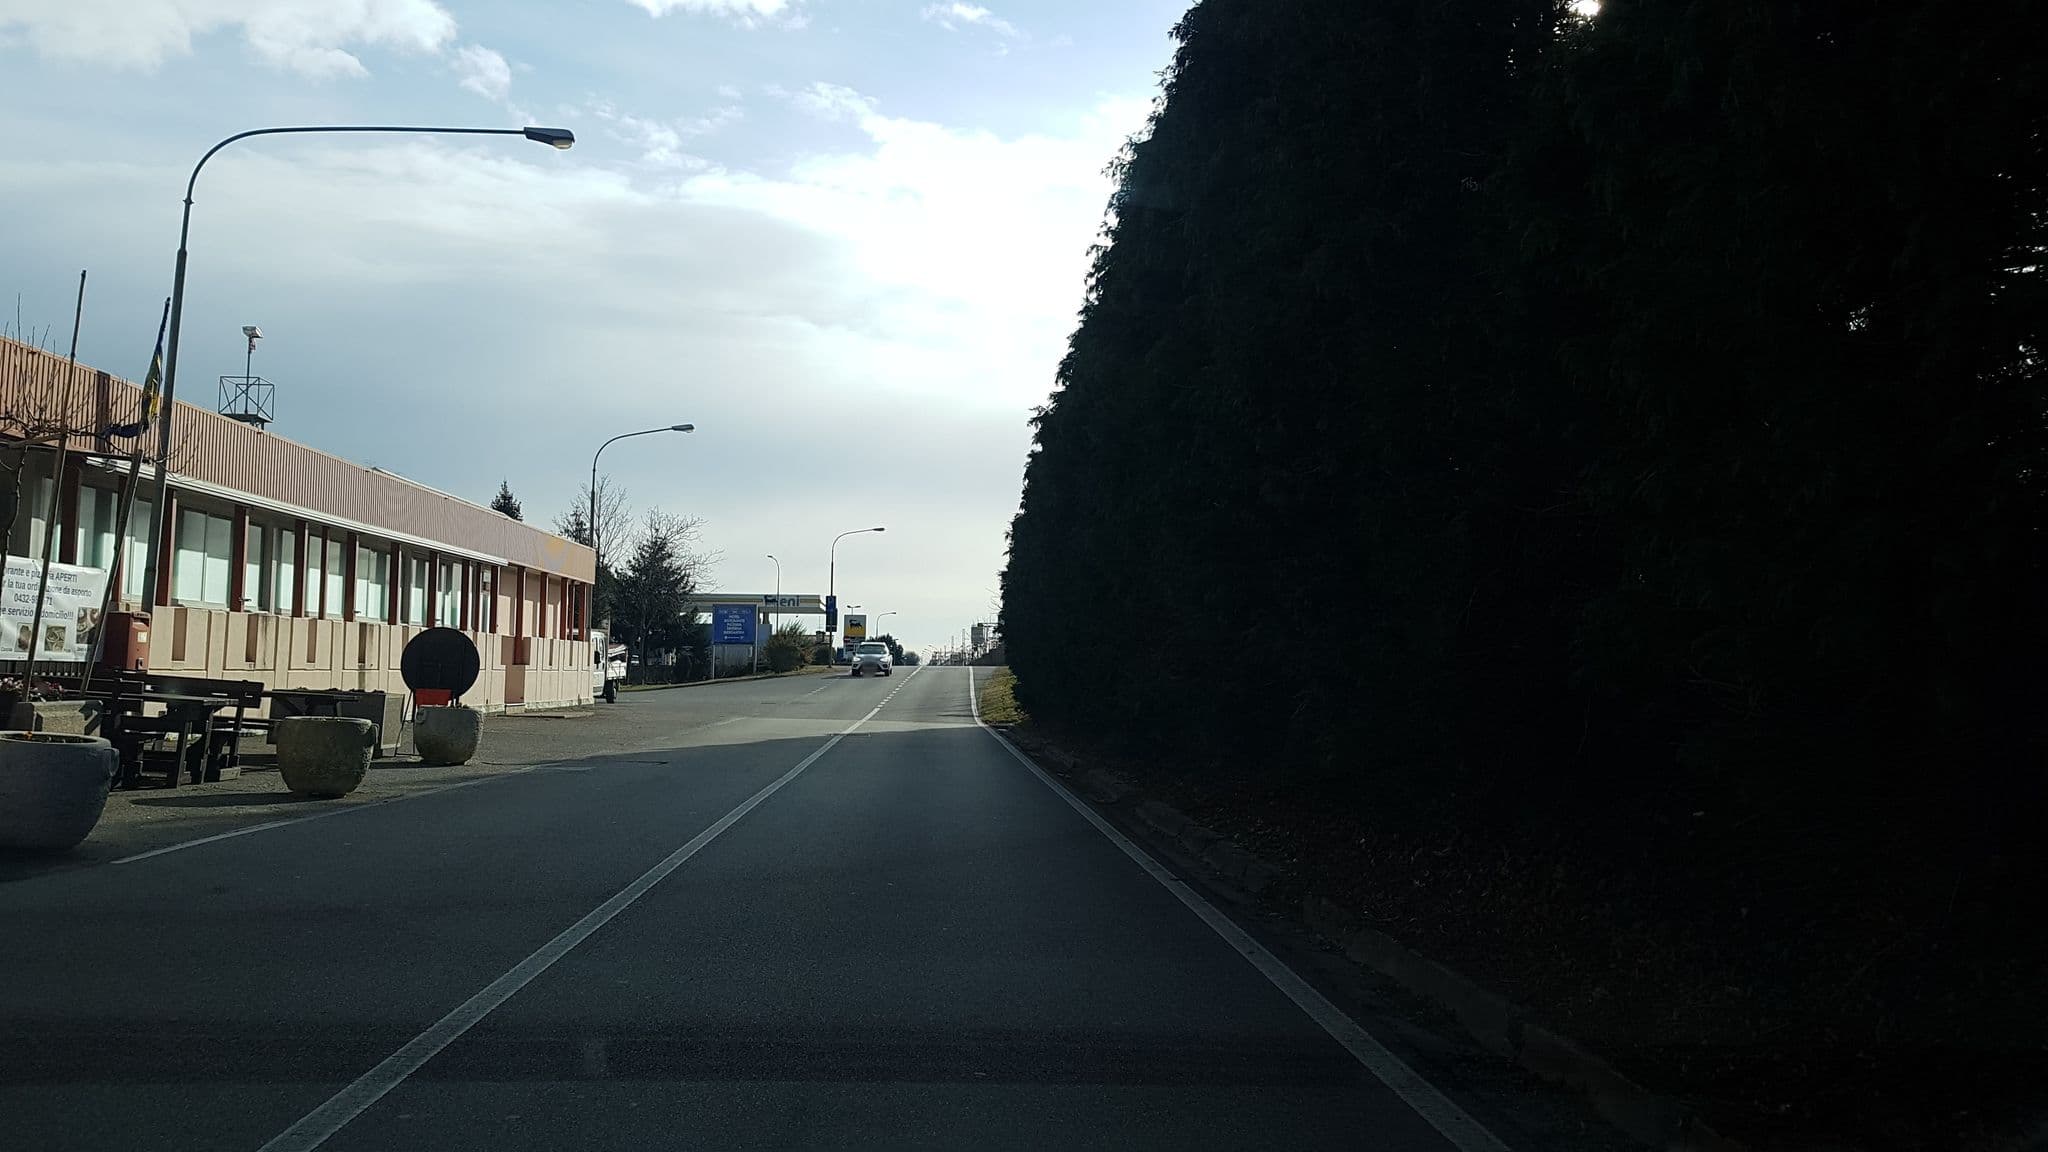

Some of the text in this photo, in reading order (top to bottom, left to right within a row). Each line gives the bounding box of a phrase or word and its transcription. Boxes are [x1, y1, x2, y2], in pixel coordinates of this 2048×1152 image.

[55, 571, 78, 583] APERTI
[15, 580, 26, 590] tua
[780, 595, 800, 607] eni
[8, 606, 34, 617] servizio
